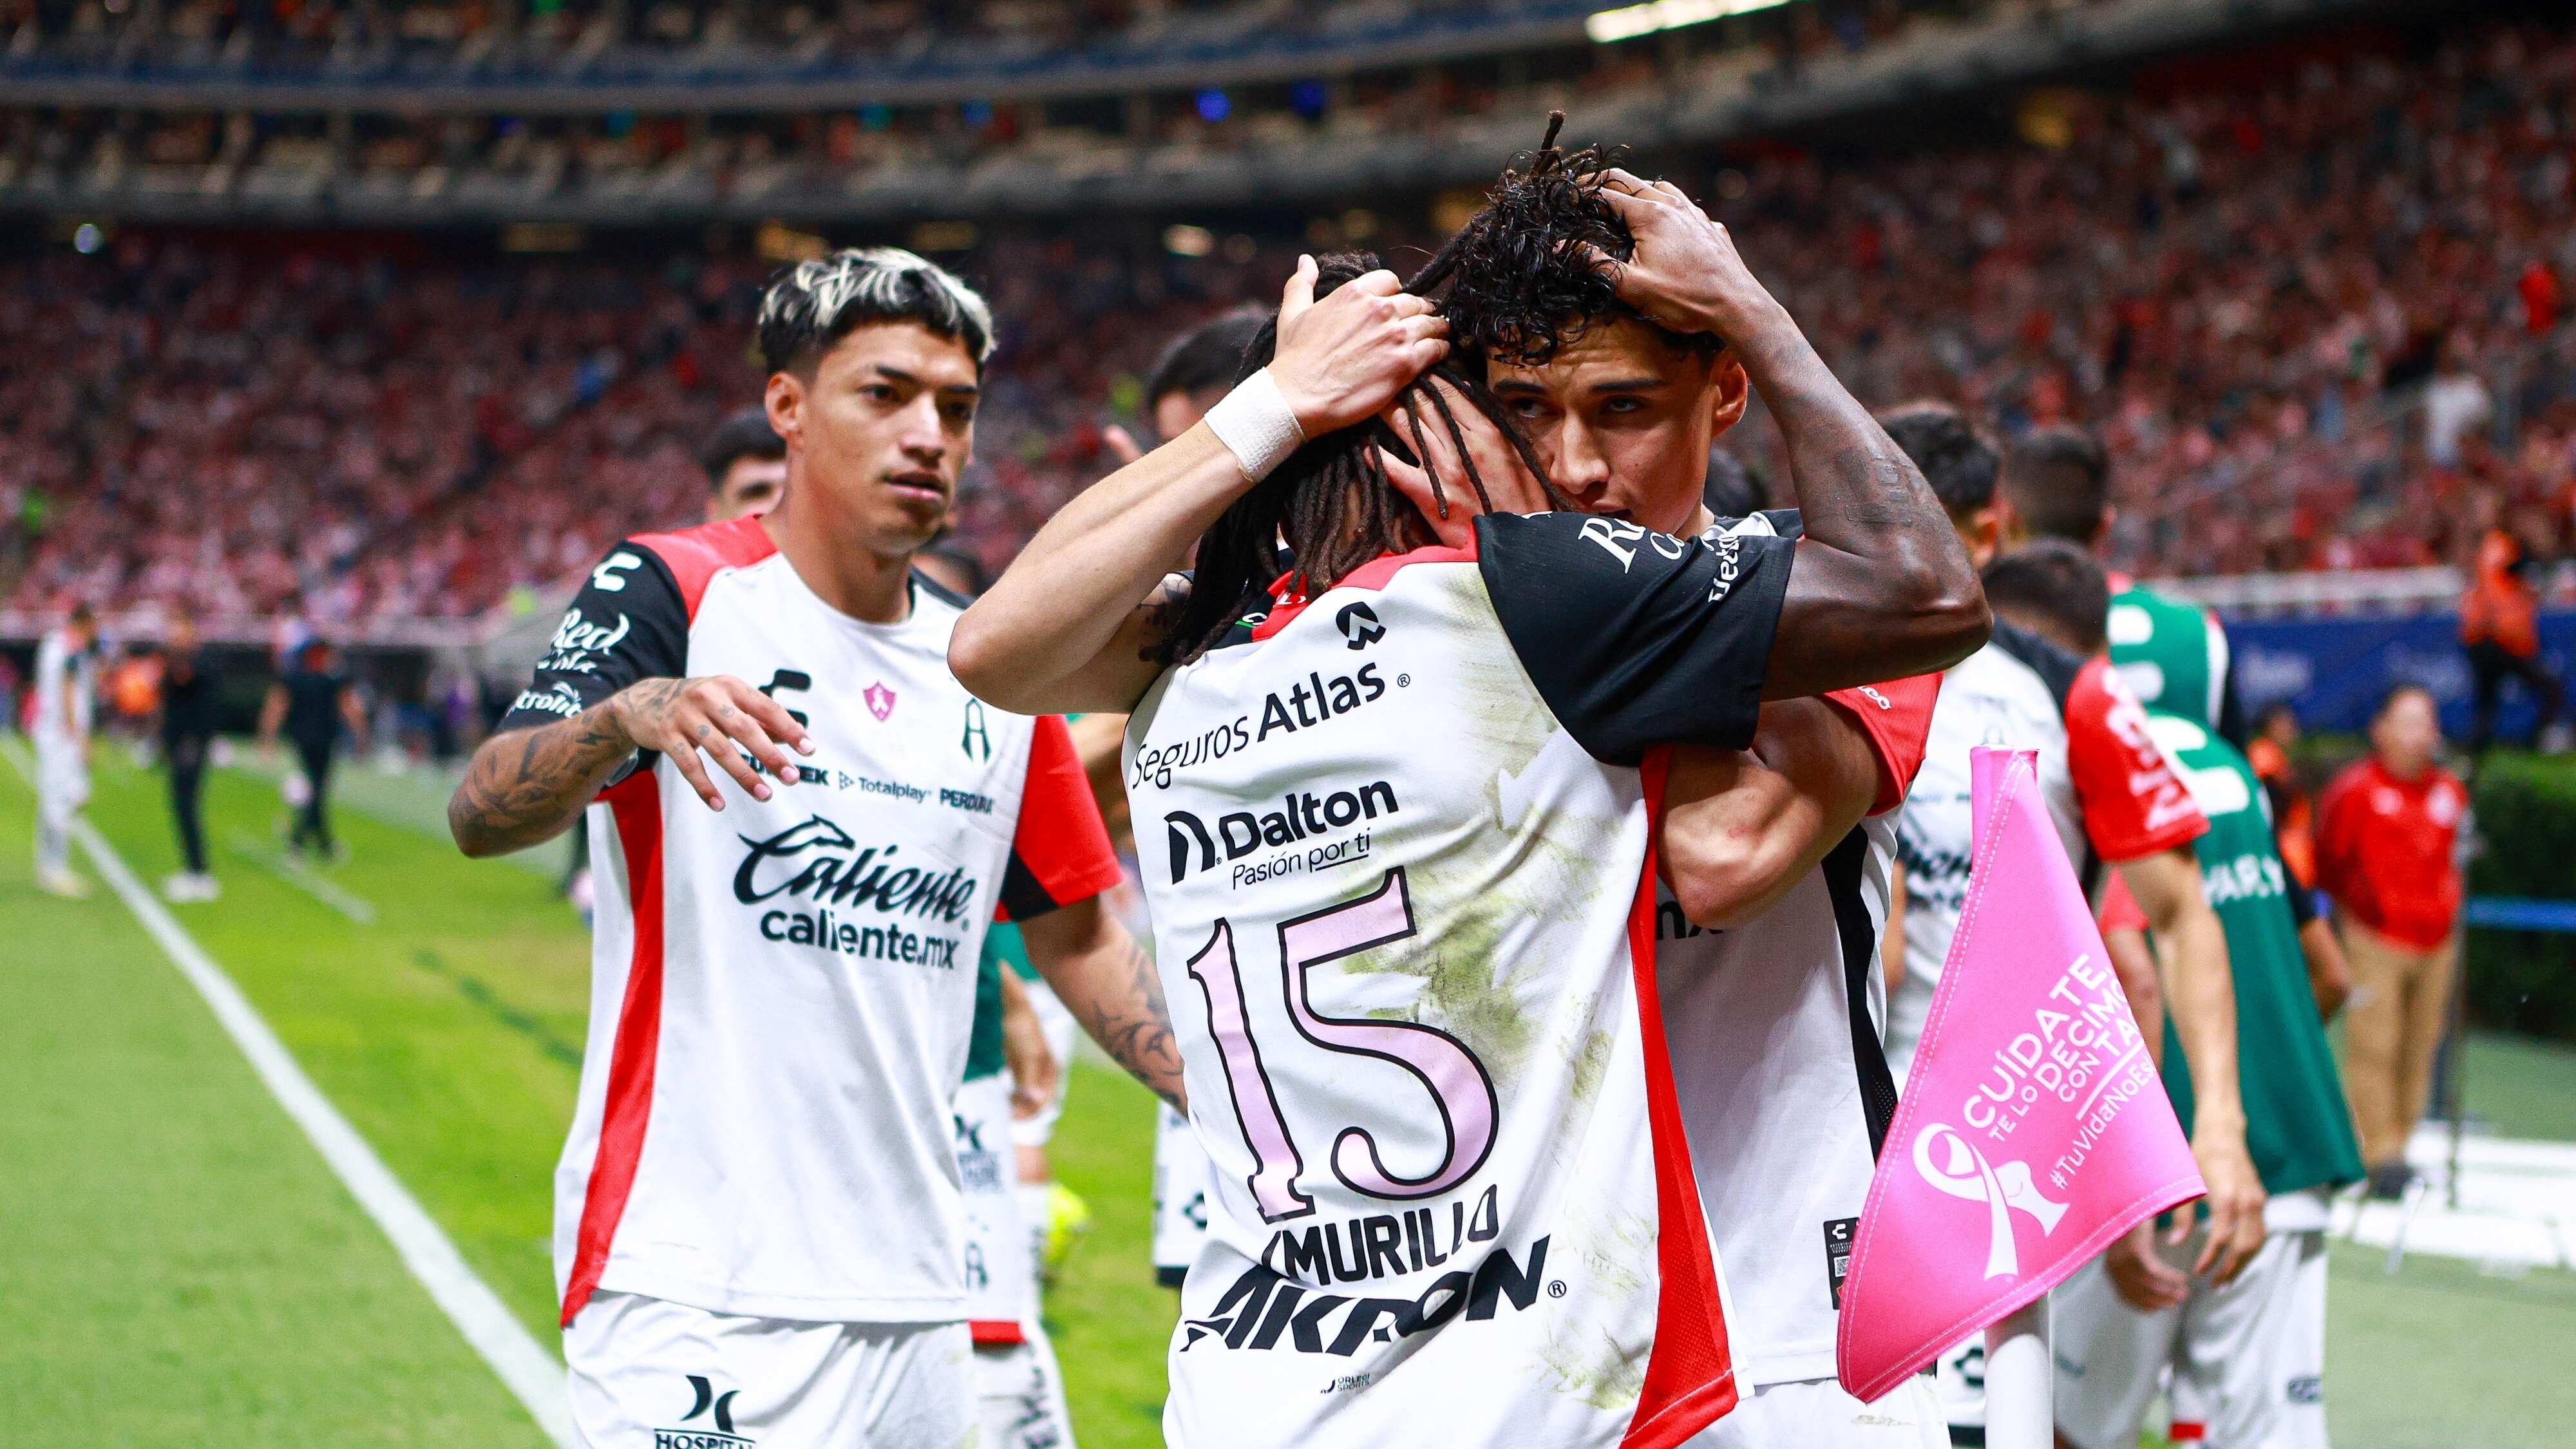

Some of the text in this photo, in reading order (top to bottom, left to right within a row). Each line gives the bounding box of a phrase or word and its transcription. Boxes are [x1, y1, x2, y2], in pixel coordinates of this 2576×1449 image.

[1132, 662, 1386, 790] Seguros Atlas
[858, 777, 929, 803] Totalplay
[1218, 781, 1399, 861] Dalton
[733, 813, 978, 923] Caliente
[1233, 827, 1371, 890] Pasión por ti
[760, 908, 960, 970] caliente.mx
[1186, 865, 1500, 1225] 15
[1988, 978, 2128, 1142] TE LO DECIMO
[2058, 1051, 2101, 1103] CON
[1179, 1233, 1551, 1358] AKRON
